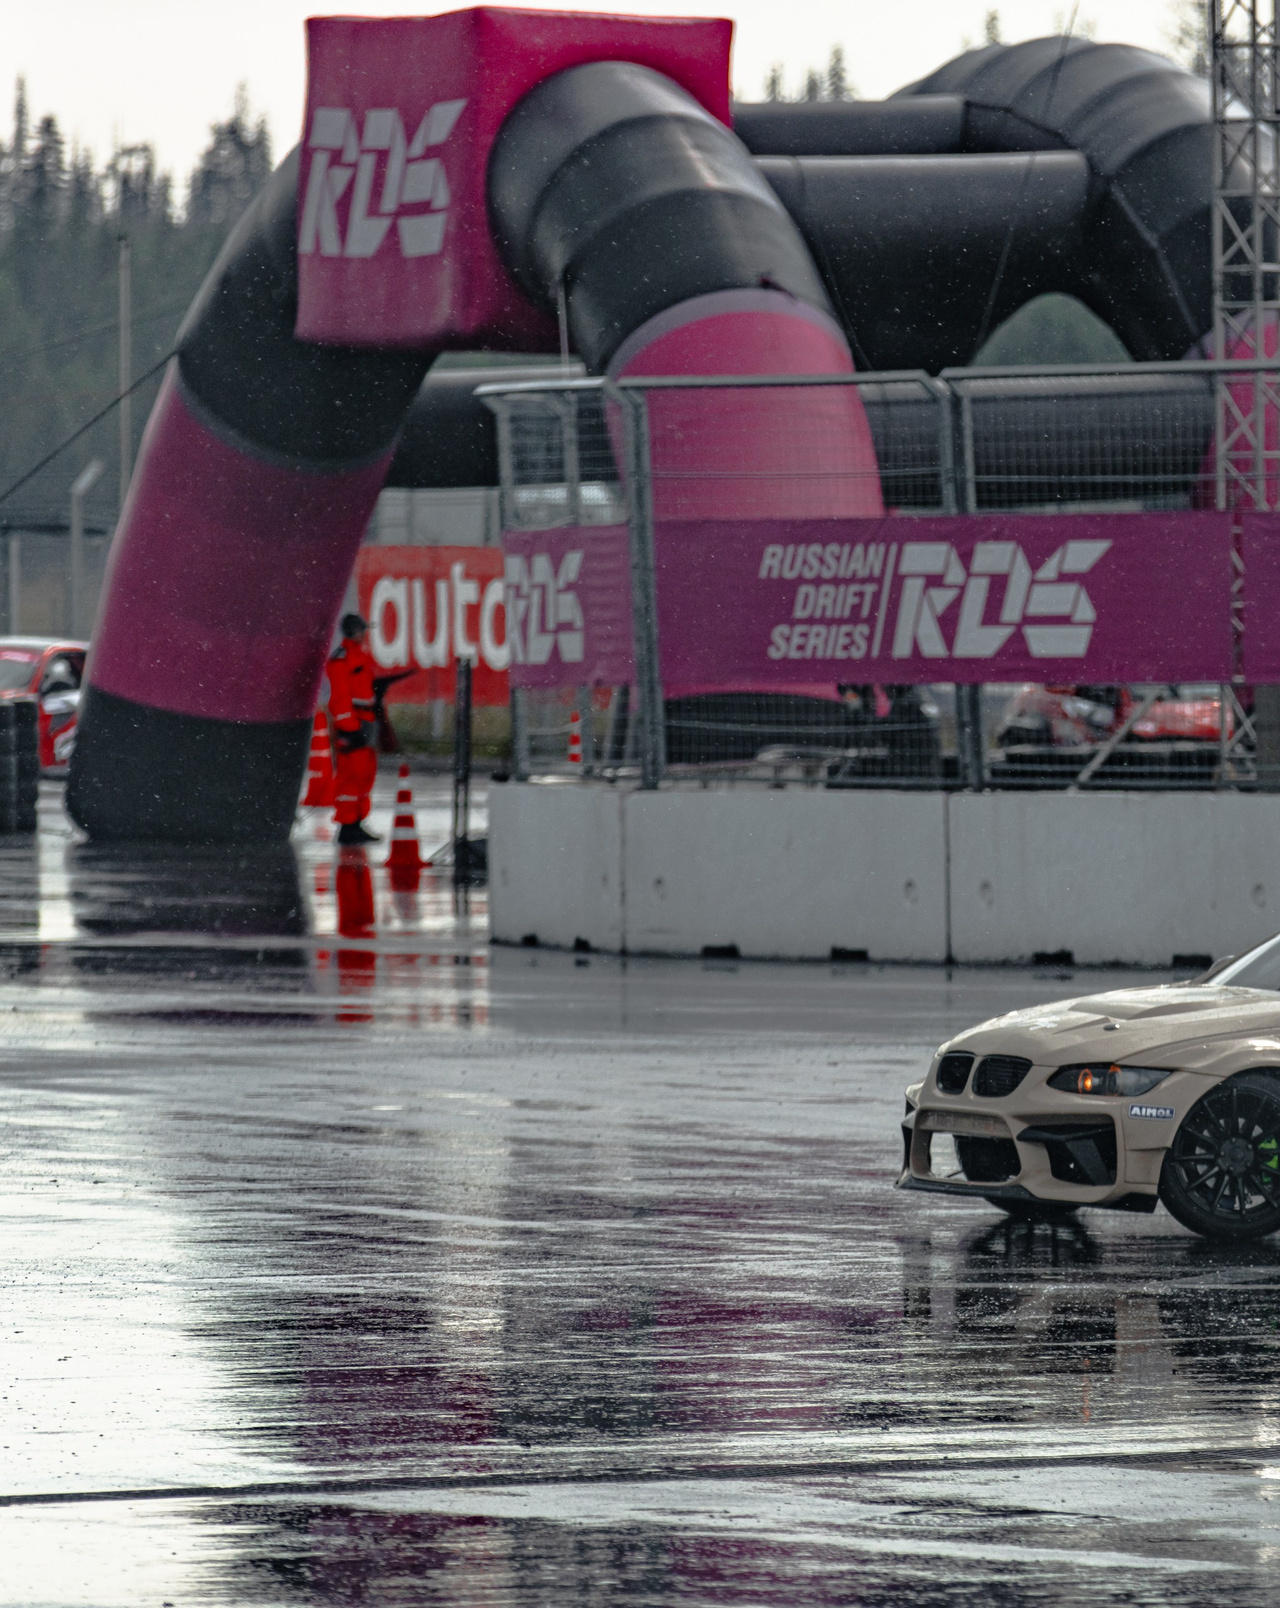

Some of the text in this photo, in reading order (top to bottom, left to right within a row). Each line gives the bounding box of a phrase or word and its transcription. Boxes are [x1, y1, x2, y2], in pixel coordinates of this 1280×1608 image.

[299, 97, 469, 259] RDS
[758, 542, 886, 579] RUSSIAN
[370, 562, 512, 671] auto
[792, 583, 878, 619] DRIFT
[891, 539, 1112, 658] RDS
[766, 623, 870, 660] SERIES
[1131, 1106, 1173, 1118] AIMOL
